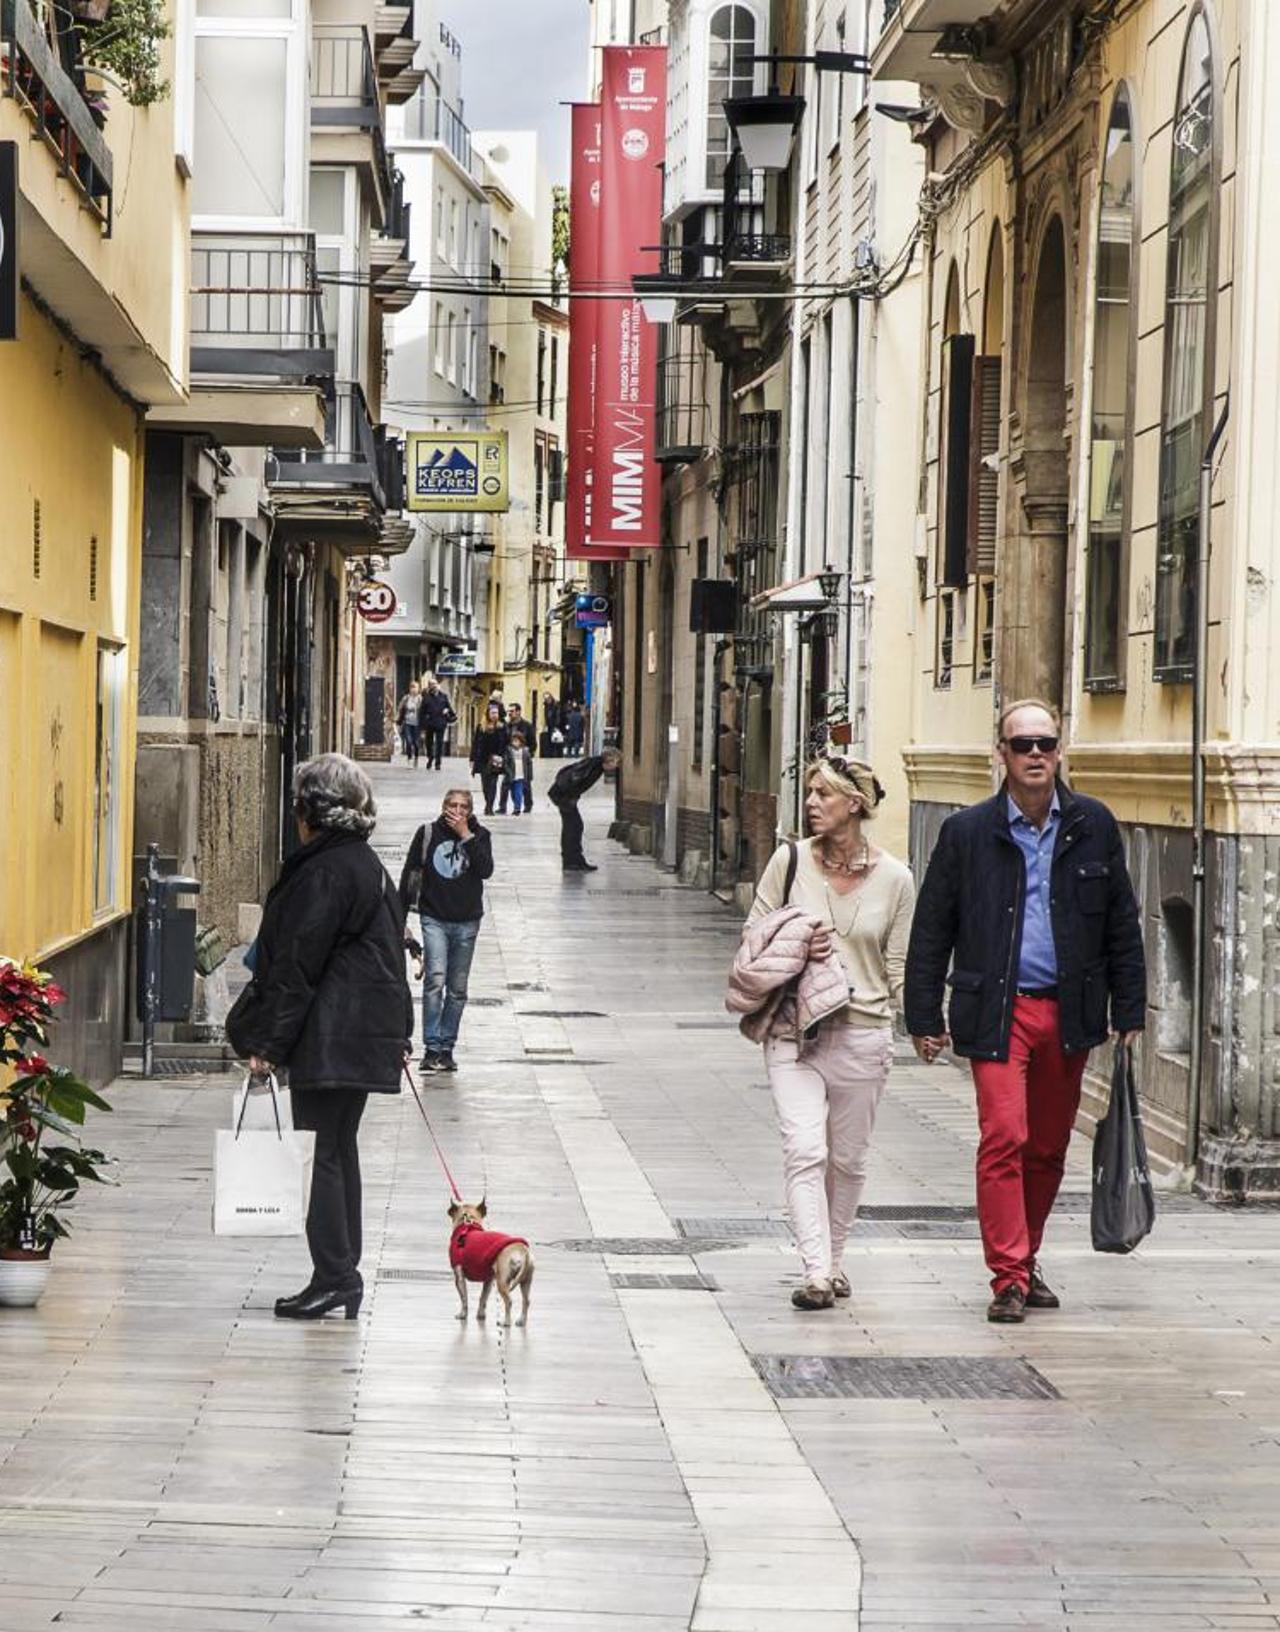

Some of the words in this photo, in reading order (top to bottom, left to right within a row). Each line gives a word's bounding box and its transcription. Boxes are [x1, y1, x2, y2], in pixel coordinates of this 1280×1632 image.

[619, 308, 630, 363] interactivo
[629, 334, 640, 375] música
[620, 365, 629, 401] museo
[629, 376, 639, 386] la
[629, 387, 639, 402] de
[418, 468, 476, 479] KEOPS
[418, 478, 475, 488] KEFREN
[359, 588, 393, 611] 30
